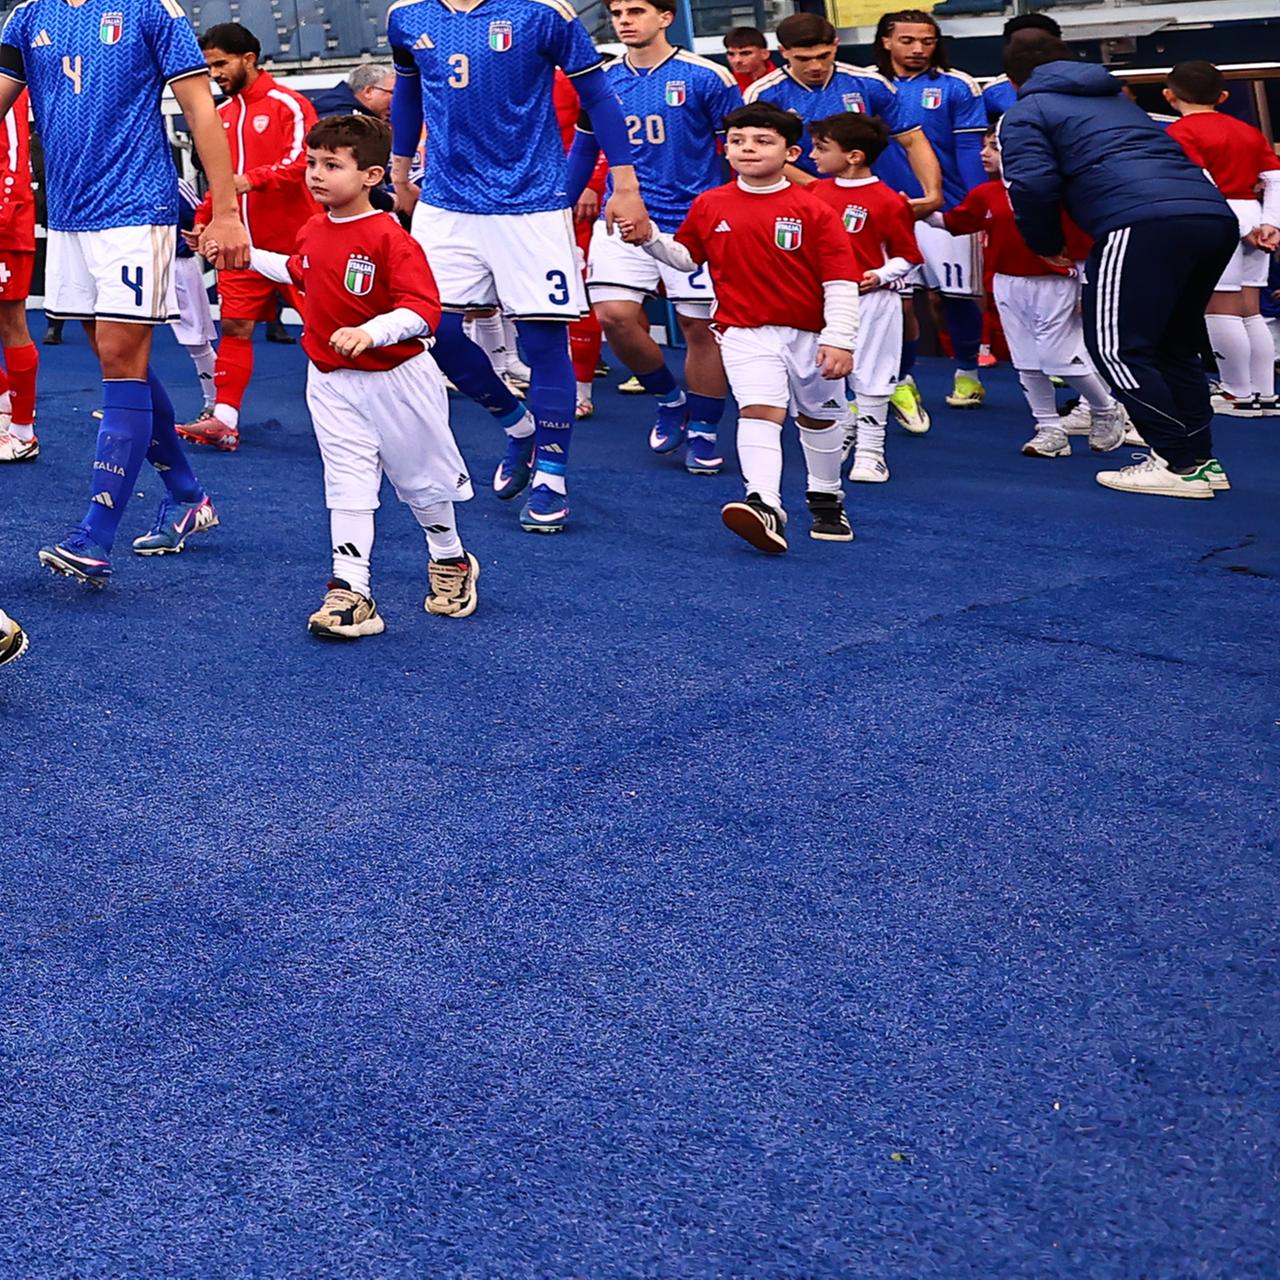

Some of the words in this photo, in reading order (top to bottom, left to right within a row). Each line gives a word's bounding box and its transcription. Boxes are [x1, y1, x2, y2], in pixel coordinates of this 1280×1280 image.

[62, 55, 81, 95] 4
[448, 53, 469, 88] 3
[625, 115, 666, 144] 20
[121, 265, 143, 306] 4
[546, 270, 570, 305] 3
[943, 262, 963, 289] 11
